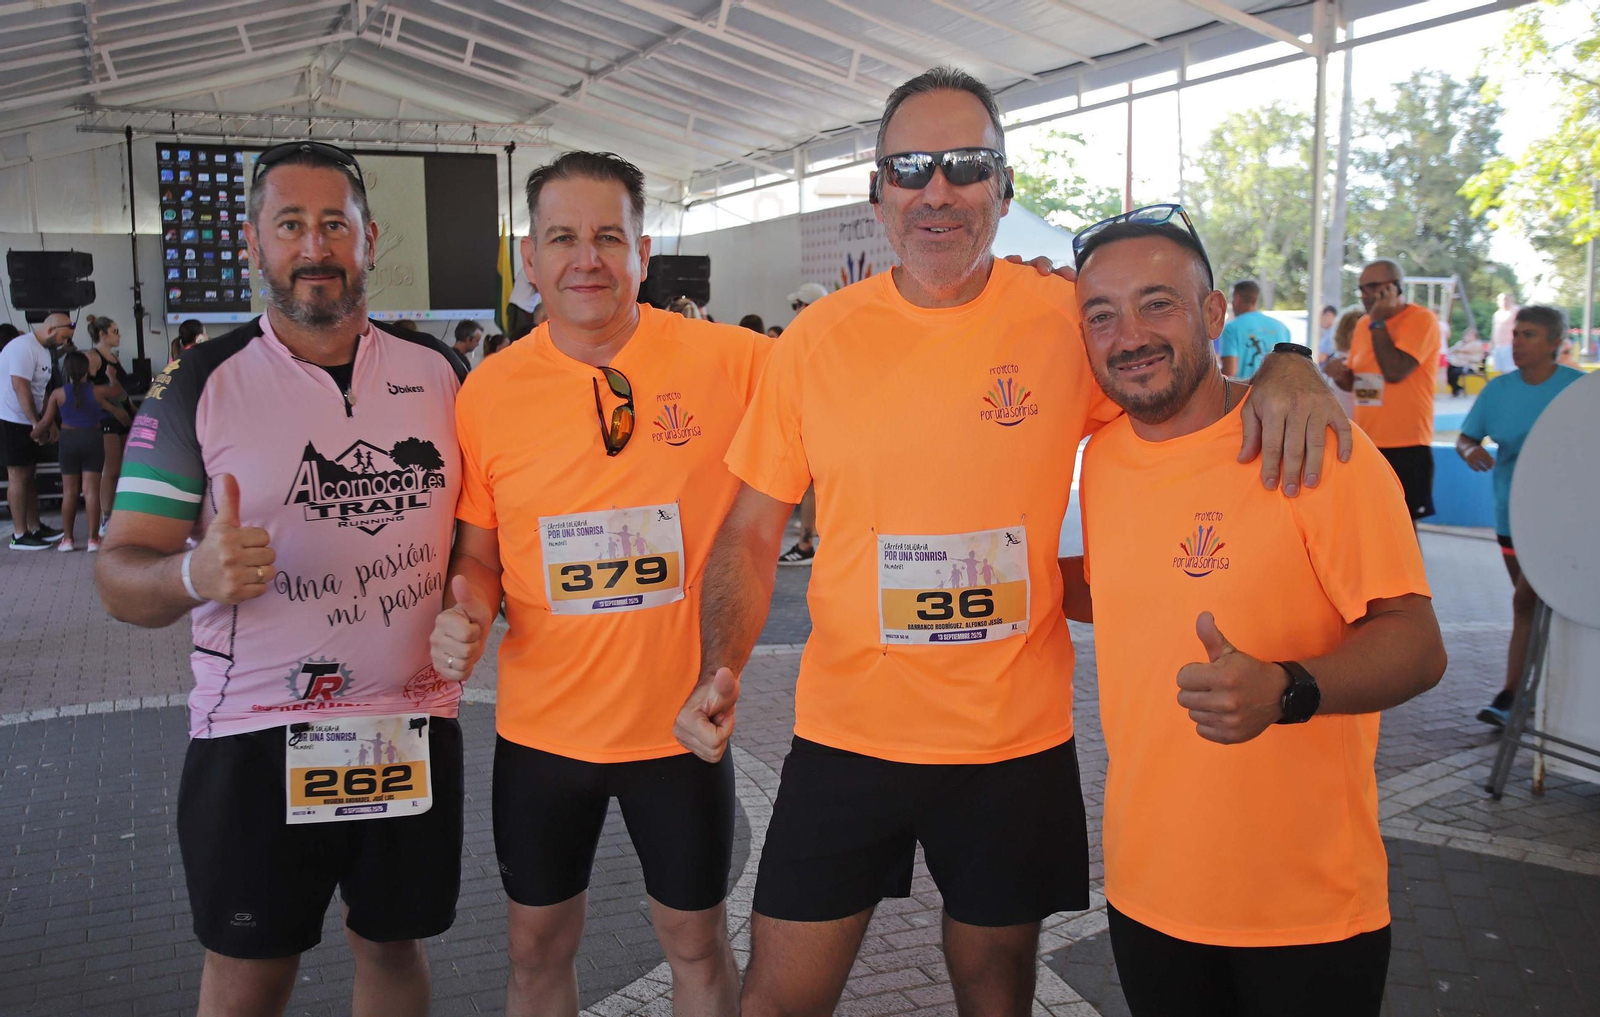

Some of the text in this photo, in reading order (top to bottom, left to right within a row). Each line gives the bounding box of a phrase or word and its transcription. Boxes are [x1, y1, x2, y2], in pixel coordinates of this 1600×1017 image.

[309, 494, 428, 518] TRAIL
[338, 515, 405, 528] RUNNING
[547, 525, 605, 539] POR UNA SONRISA
[884, 550, 948, 562] POR UNA SONRISA
[274, 570, 343, 602] Una
[561, 556, 668, 592] 379
[327, 571, 443, 628] mi pasión
[916, 588, 994, 621] 36
[965, 620, 988, 628] ALFONSO
[988, 617, 1003, 625] JESÚS
[943, 632, 971, 640] SEPTIEMBRE
[970, 631, 983, 639] 2025
[301, 662, 344, 701] TR
[309, 732, 324, 742] UNA
[326, 732, 357, 742] SONRISA
[305, 765, 413, 798] 262
